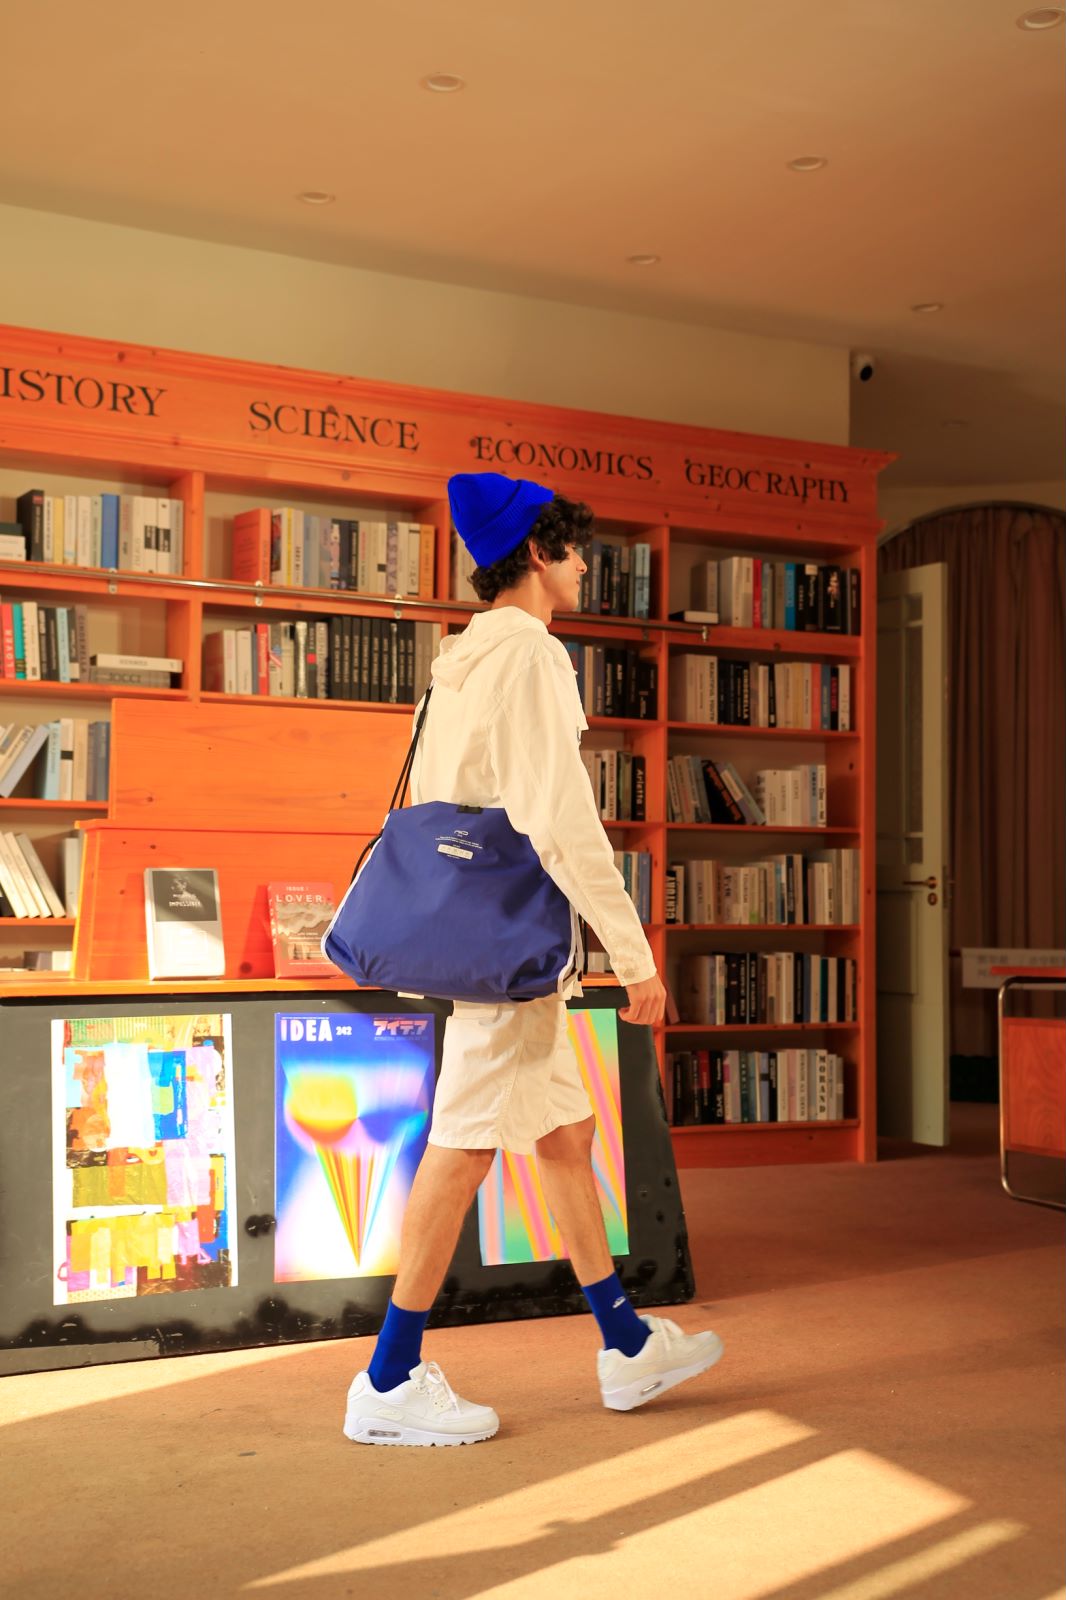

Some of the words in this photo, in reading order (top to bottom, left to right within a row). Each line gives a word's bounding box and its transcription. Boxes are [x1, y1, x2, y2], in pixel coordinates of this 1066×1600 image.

[249, 401, 421, 452] SCIENCE
[474, 435, 654, 482] ECONOMICS
[276, 894, 324, 903] LOVER
[664, 875, 676, 919] CENTURY
[280, 1019, 333, 1042] IDEA
[336, 1026, 353, 1036] 242
[373, 1020, 429, 1036] アイデア
